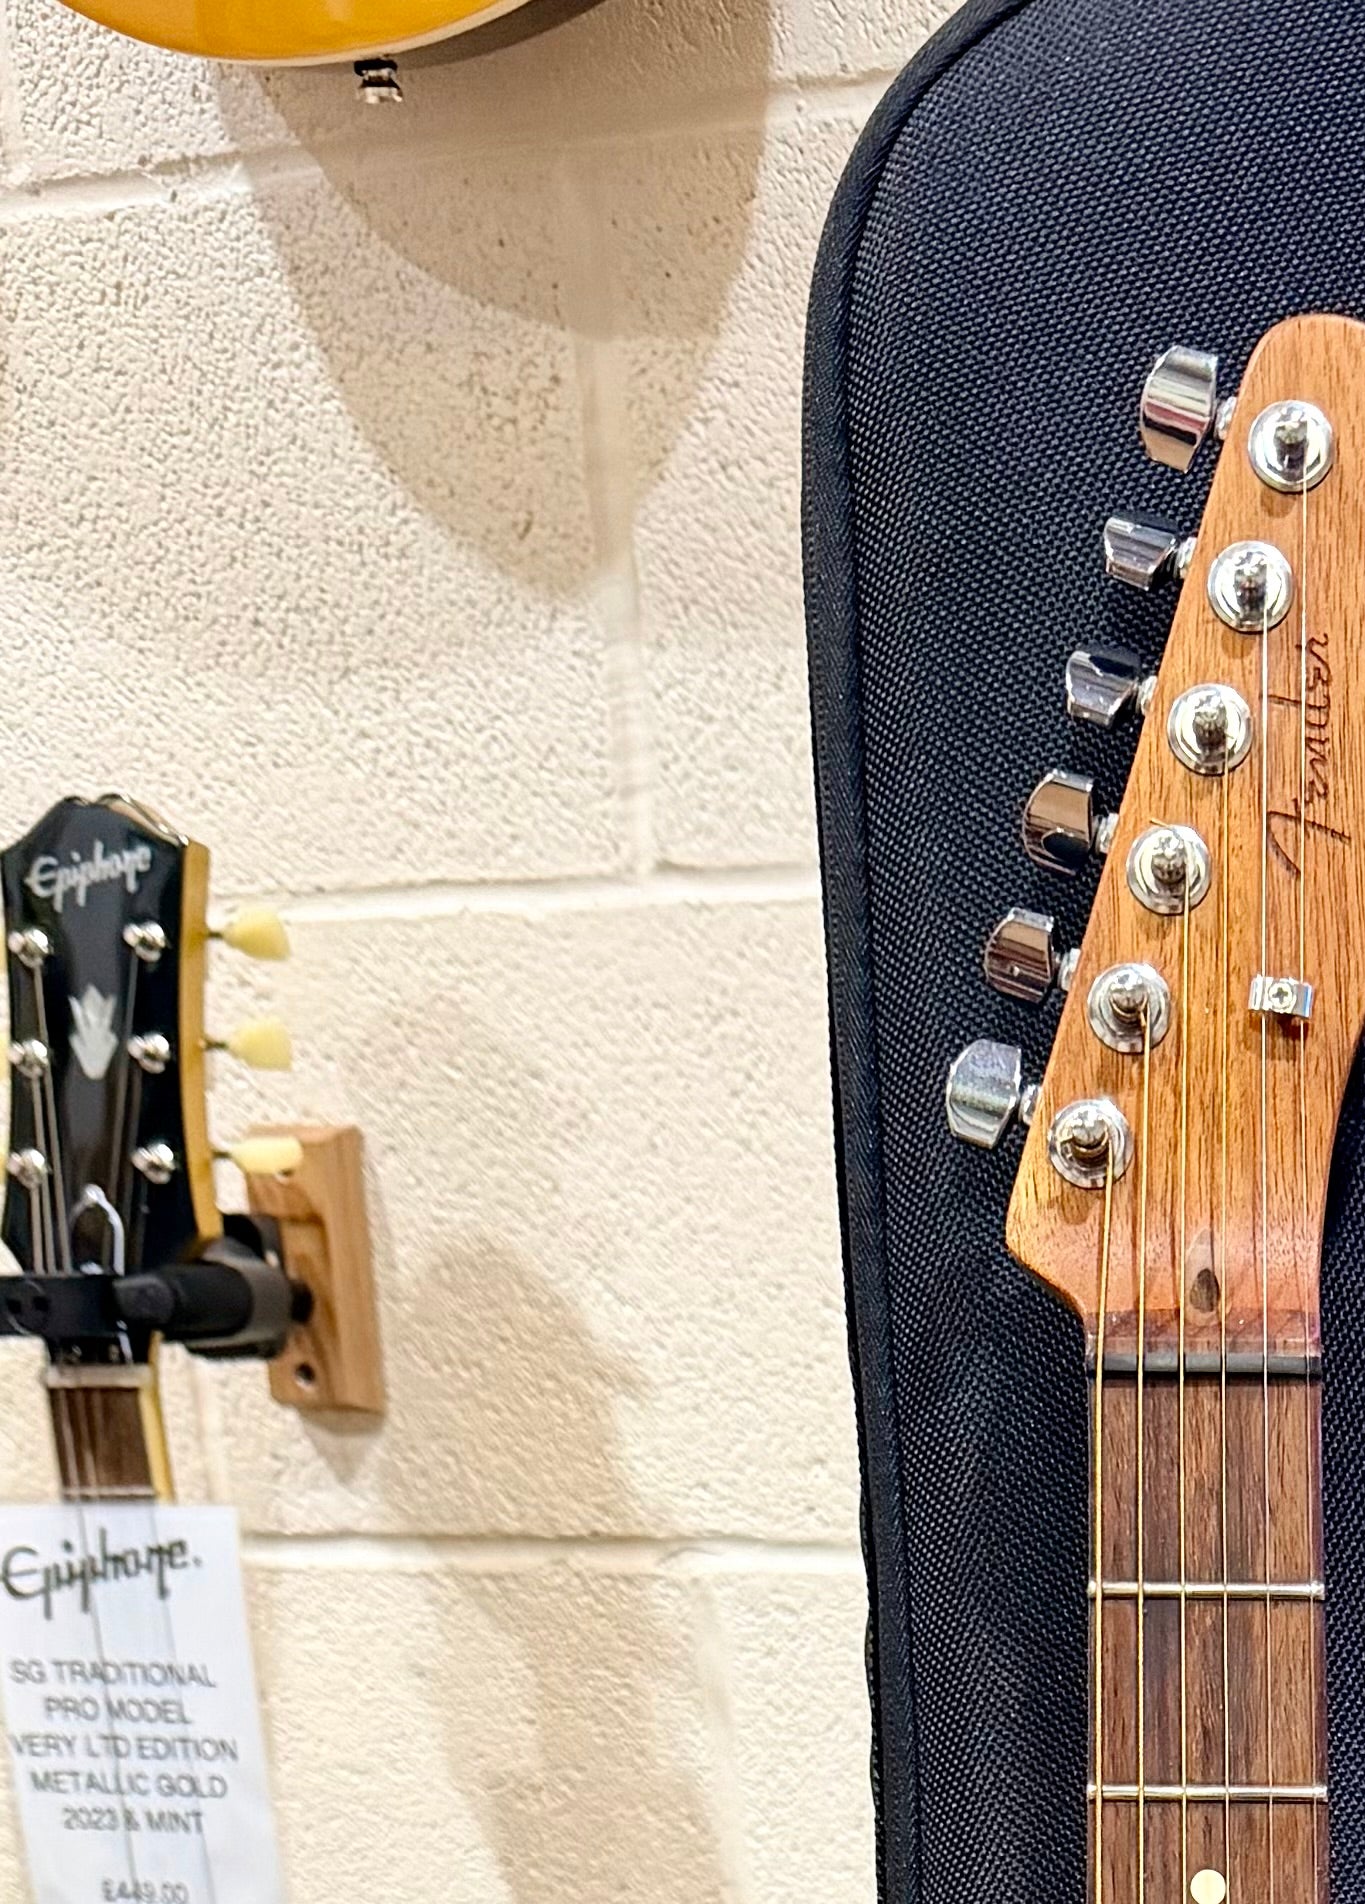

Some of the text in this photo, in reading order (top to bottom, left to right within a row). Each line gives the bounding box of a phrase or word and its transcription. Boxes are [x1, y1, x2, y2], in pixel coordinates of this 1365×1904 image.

[1262, 632, 1352, 876] Fender
[24, 839, 152, 913] Epiphone
[9, 1660, 216, 1688] SG TRADITIONAL
[44, 1697, 192, 1725] PRO MODEL
[10, 1734, 239, 1761] VERY LTD EDITION
[31, 1772, 228, 1799] METALLIC GOLD
[63, 1807, 203, 1834] 2023 & MINT
